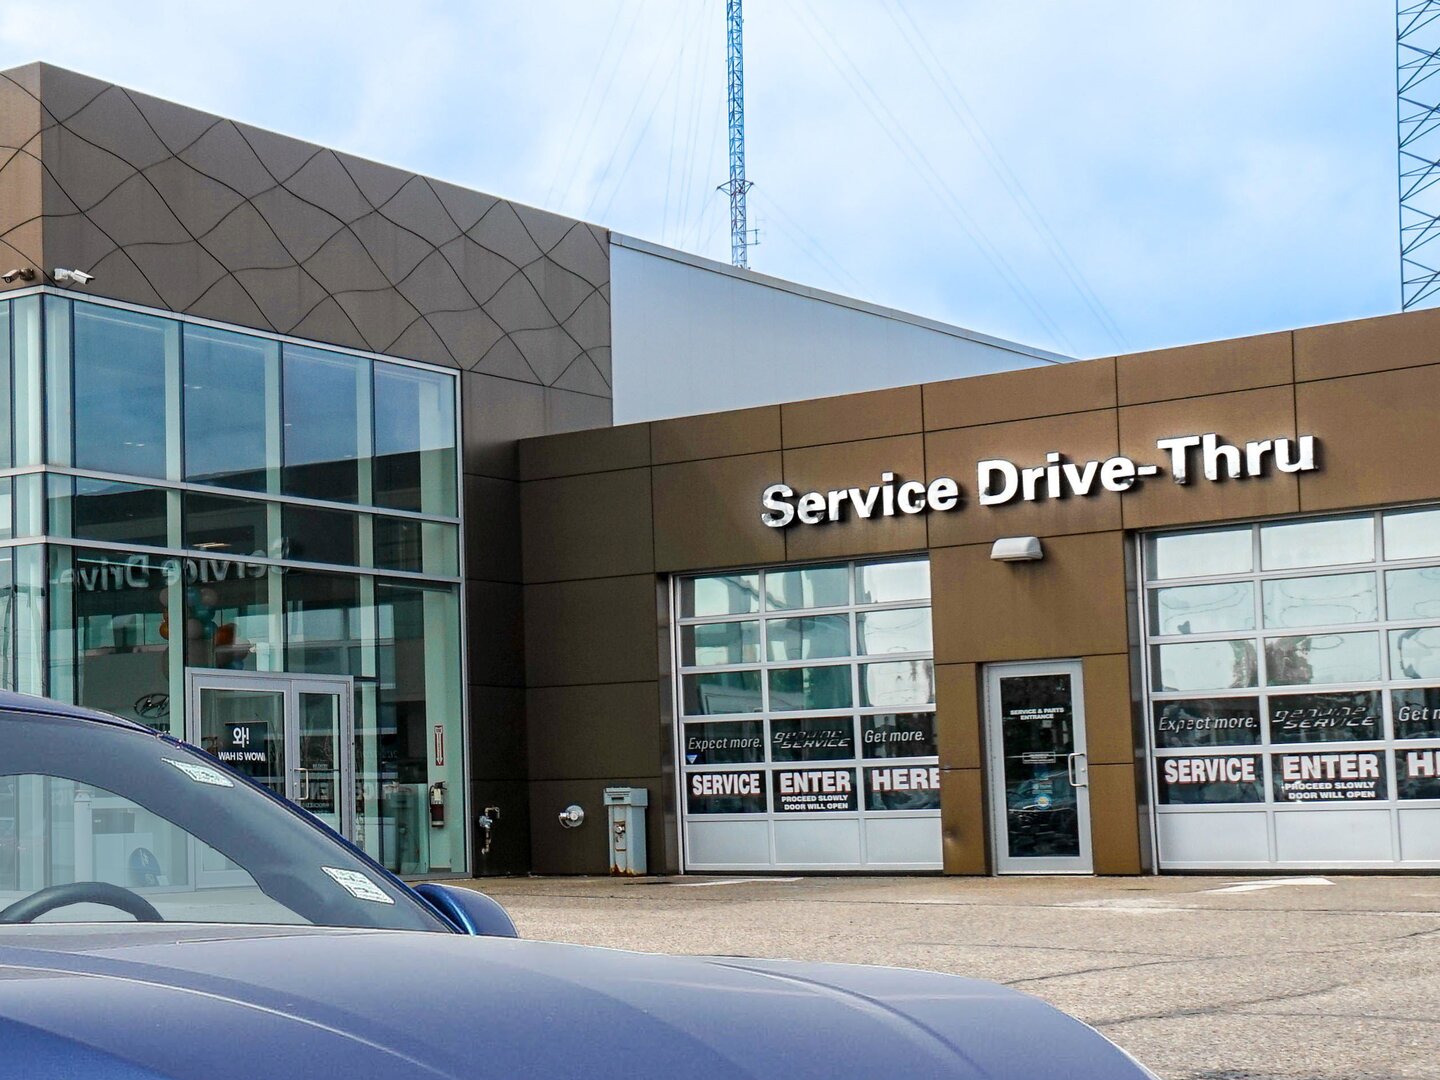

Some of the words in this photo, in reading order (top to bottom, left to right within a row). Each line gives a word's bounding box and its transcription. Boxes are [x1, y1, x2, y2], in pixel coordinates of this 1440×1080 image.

[760, 471, 960, 528] Service
[977, 432, 1318, 506] Drive-Thru
[1398, 706, 1429, 723] Get
[1158, 716, 1211, 733] Expect
[1214, 717, 1258, 730] more.
[1282, 715, 1378, 730] SERVICE
[688, 736, 728, 752] Expect
[730, 736, 763, 749] more.
[780, 737, 852, 749] SERVICE
[864, 729, 889, 744] Get
[891, 730, 925, 743] more.
[217, 752, 237, 761] WAH
[237, 752, 245, 761] IS
[1163, 757, 1257, 784] SERVICE
[1282, 754, 1380, 781] ENTER
[692, 773, 761, 796] SERVICE
[779, 770, 852, 794] ENTER
[871, 767, 941, 791] HERE
[1284, 782, 1333, 791] PROCEED
[1334, 781, 1376, 790] SLOWLY
[781, 795, 817, 803] PROCEED
[817, 794, 849, 802] SLOWLY
[1288, 791, 1318, 800] DOOR
[1319, 791, 1345, 799] WILL
[1346, 790, 1376, 799] OPEN
[826, 802, 849, 810] OPEN
